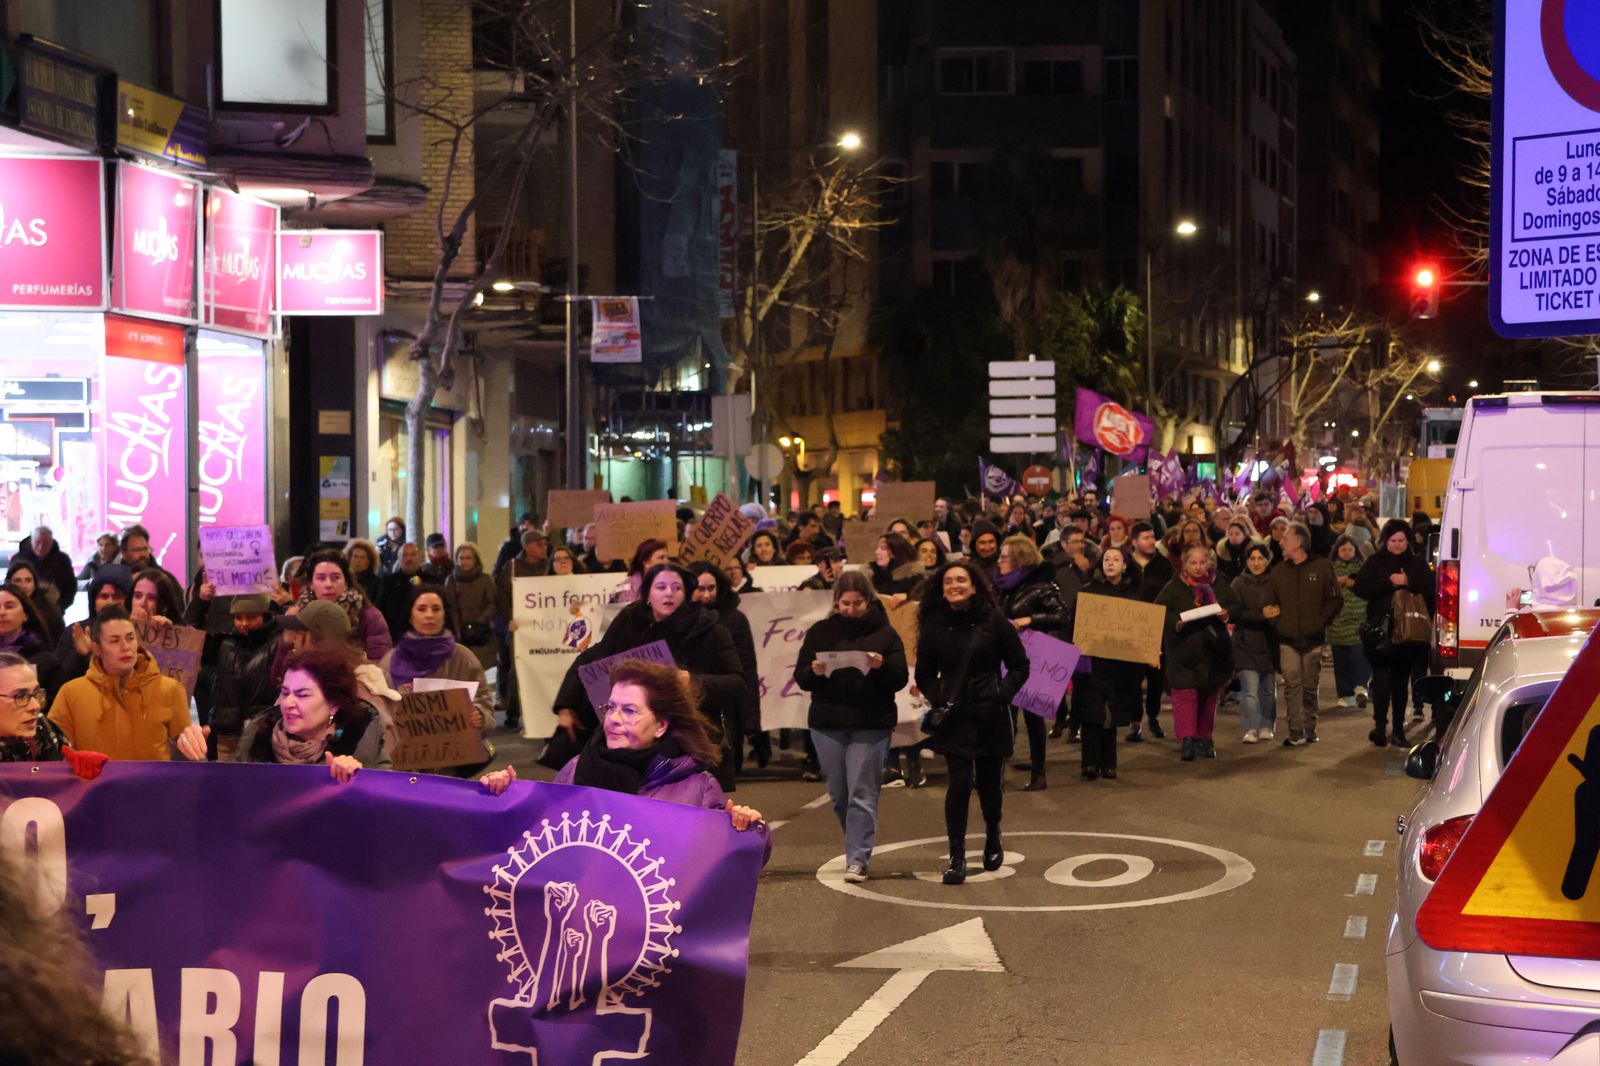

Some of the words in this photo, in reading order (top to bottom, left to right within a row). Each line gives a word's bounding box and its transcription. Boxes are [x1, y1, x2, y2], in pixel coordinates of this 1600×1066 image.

[1535, 166, 1553, 185] de
[1558, 165, 1567, 183] 9
[1572, 167, 1581, 181] a
[1523, 210, 1600, 231] Domingos
[1508, 248, 1553, 268] ZONA
[1558, 245, 1580, 265] DE
[1520, 267, 1597, 289] LIMITADO
[12, 282, 93, 296] PERFUMERÍAS
[1535, 290, 1593, 311] TICKET
[695, 494, 731, 545] CUERPO
[713, 509, 751, 556] REGLAS
[525, 592, 556, 609] Sin
[1117, 599, 1149, 624] VIVA
[533, 619, 555, 631] No
